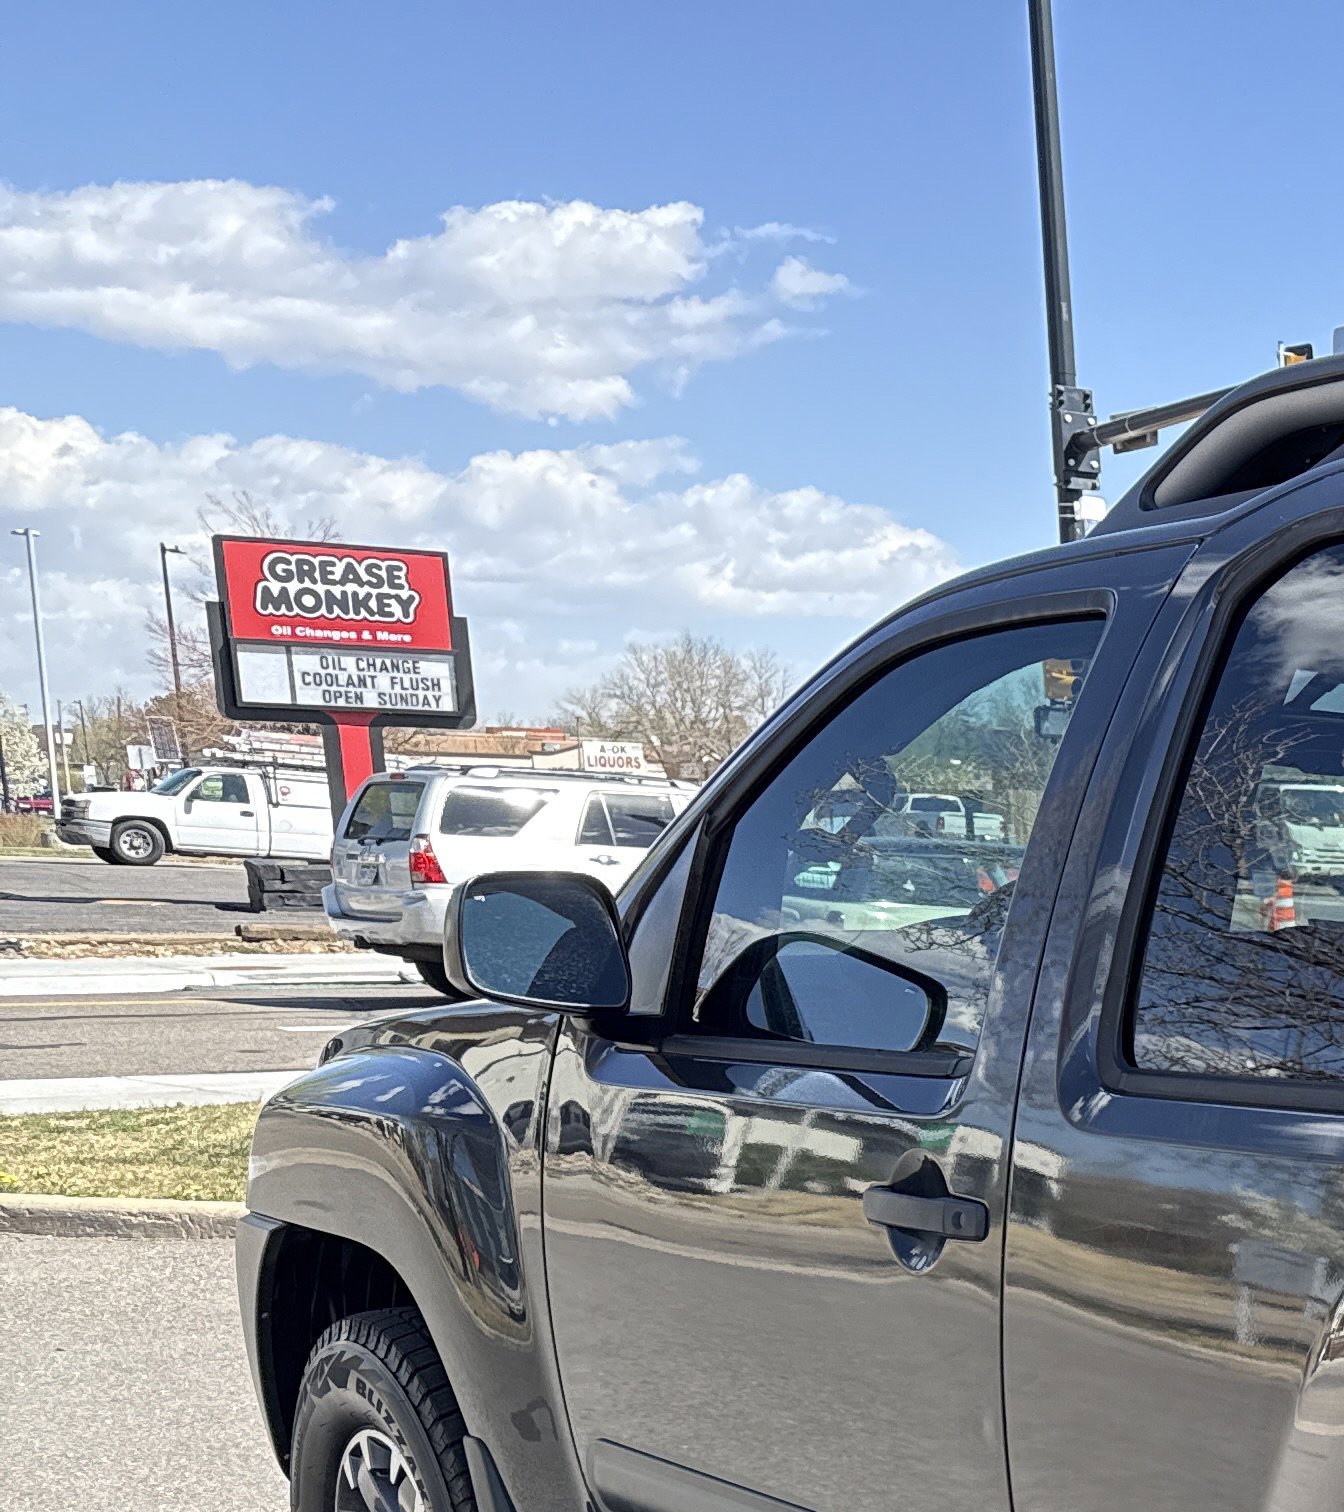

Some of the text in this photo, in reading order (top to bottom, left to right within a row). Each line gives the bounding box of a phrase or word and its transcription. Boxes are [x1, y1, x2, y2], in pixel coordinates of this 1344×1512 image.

[266, 555, 405, 591] GREASE
[260, 585, 416, 619] MONKEY
[271, 625, 412, 643] Oil Changes & More
[319, 656, 421, 675] OIL CHANGE
[301, 672, 442, 692] COOLANT FLUSH
[322, 690, 443, 709] OPEN SUNDAY
[600, 745, 627, 754] A-OK
[587, 755, 641, 769] LIQUORS
[355, 1376, 430, 1505] BLIZZAK
